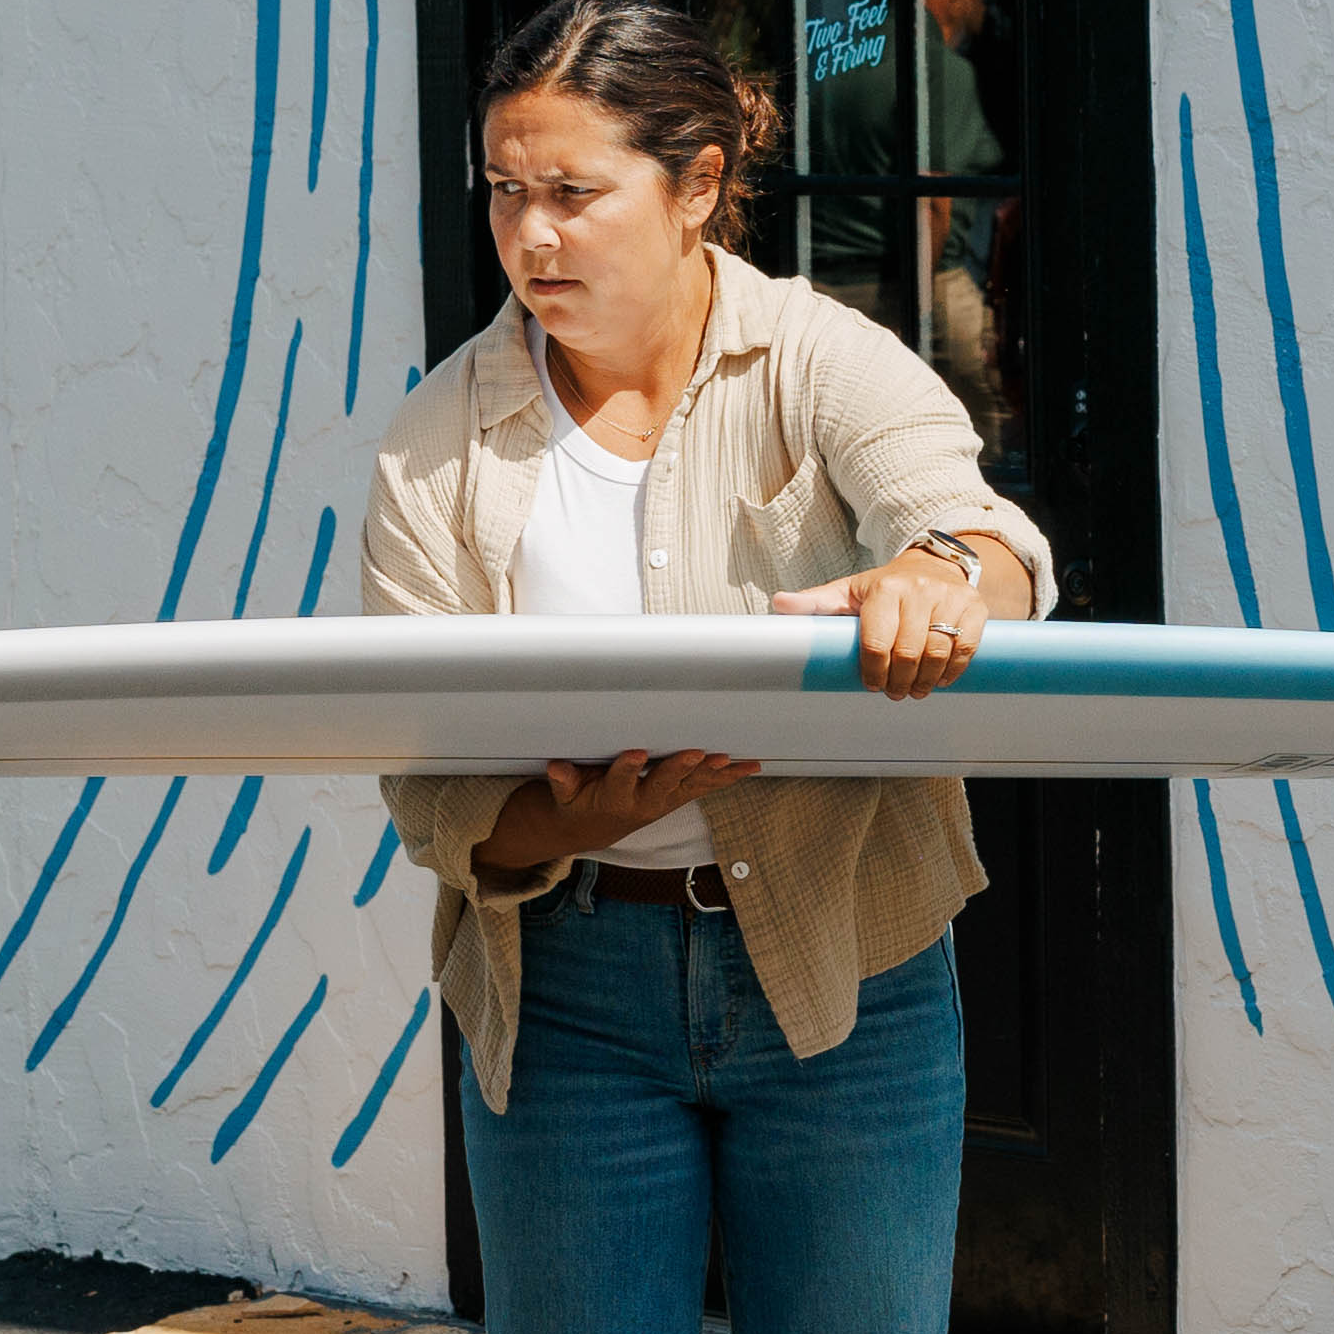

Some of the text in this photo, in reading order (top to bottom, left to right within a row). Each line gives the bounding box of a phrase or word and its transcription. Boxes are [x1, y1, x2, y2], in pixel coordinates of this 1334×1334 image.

[805, 17, 845, 55] Two
[814, 34, 886, 82] & Firing
